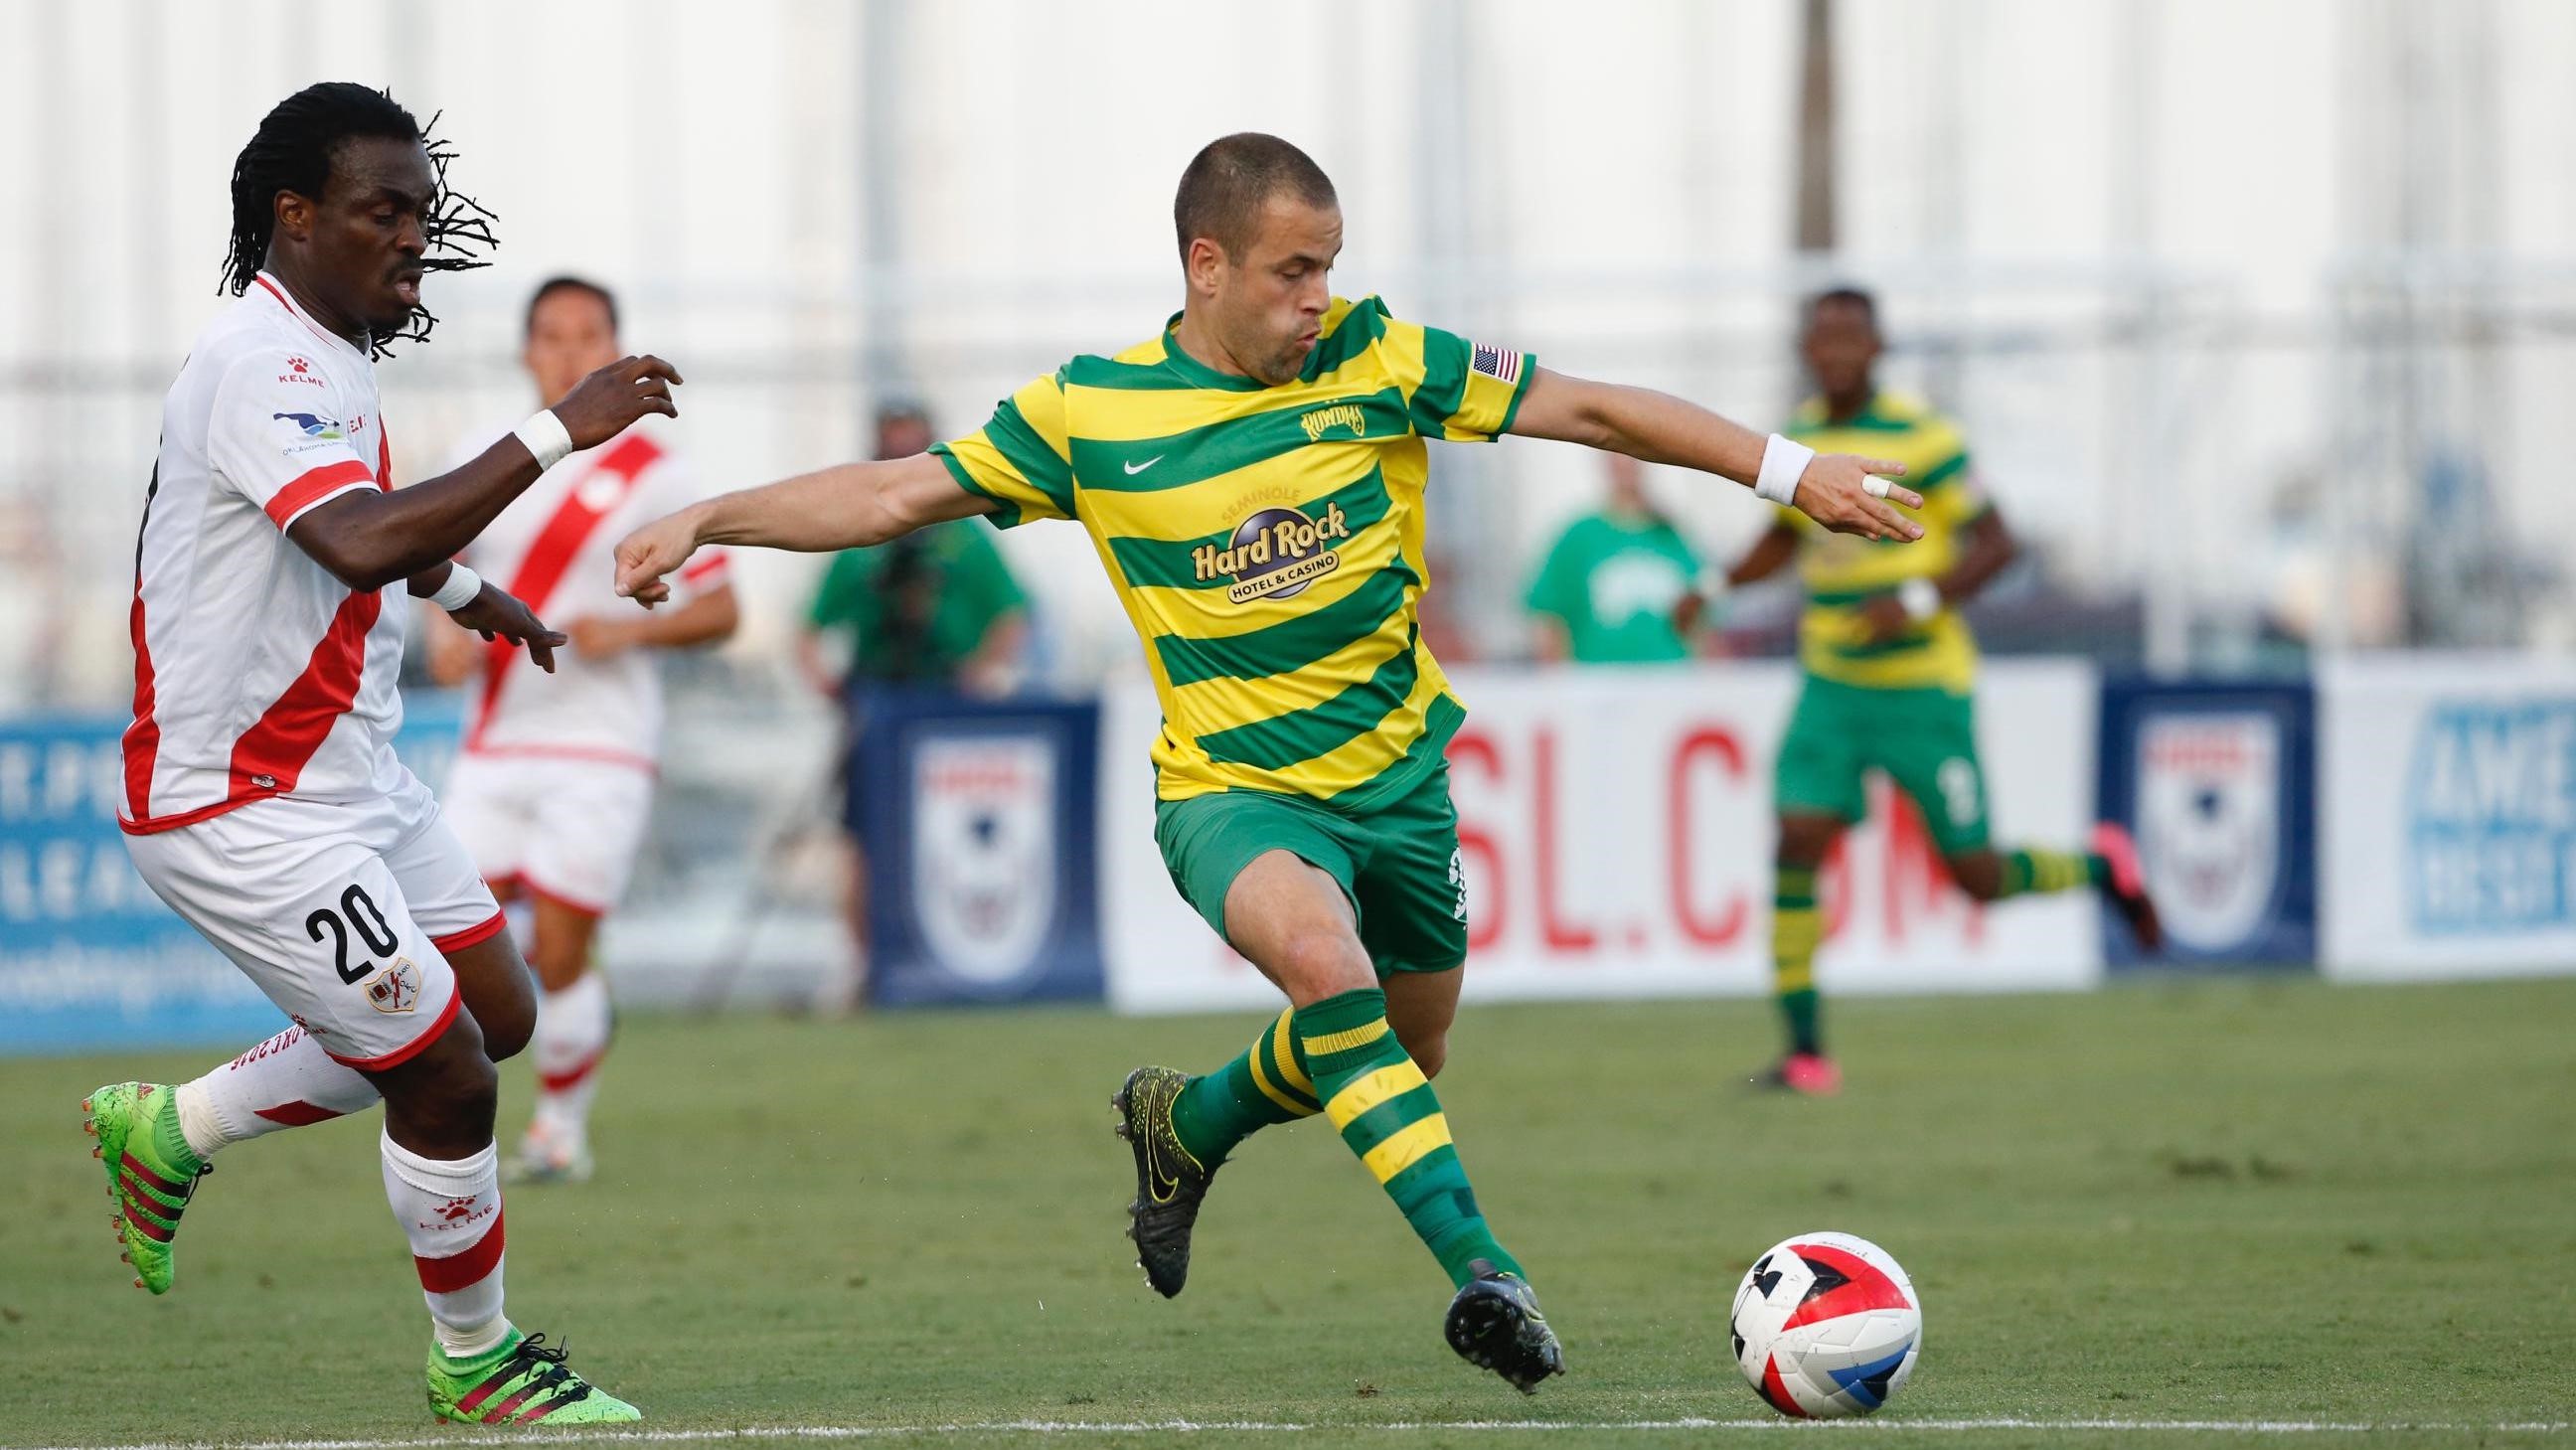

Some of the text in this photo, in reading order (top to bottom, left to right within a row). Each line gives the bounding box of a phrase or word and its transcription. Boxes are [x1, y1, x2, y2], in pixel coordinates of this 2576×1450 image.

[278, 375, 325, 389] KELME
[1221, 486, 1301, 525] SEMINOLE
[1192, 501, 1350, 581] Hard Rock
[1232, 555, 1335, 598] HOTEL & CASINO
[305, 884, 399, 985] 20
[419, 1204, 493, 1230] KELME
